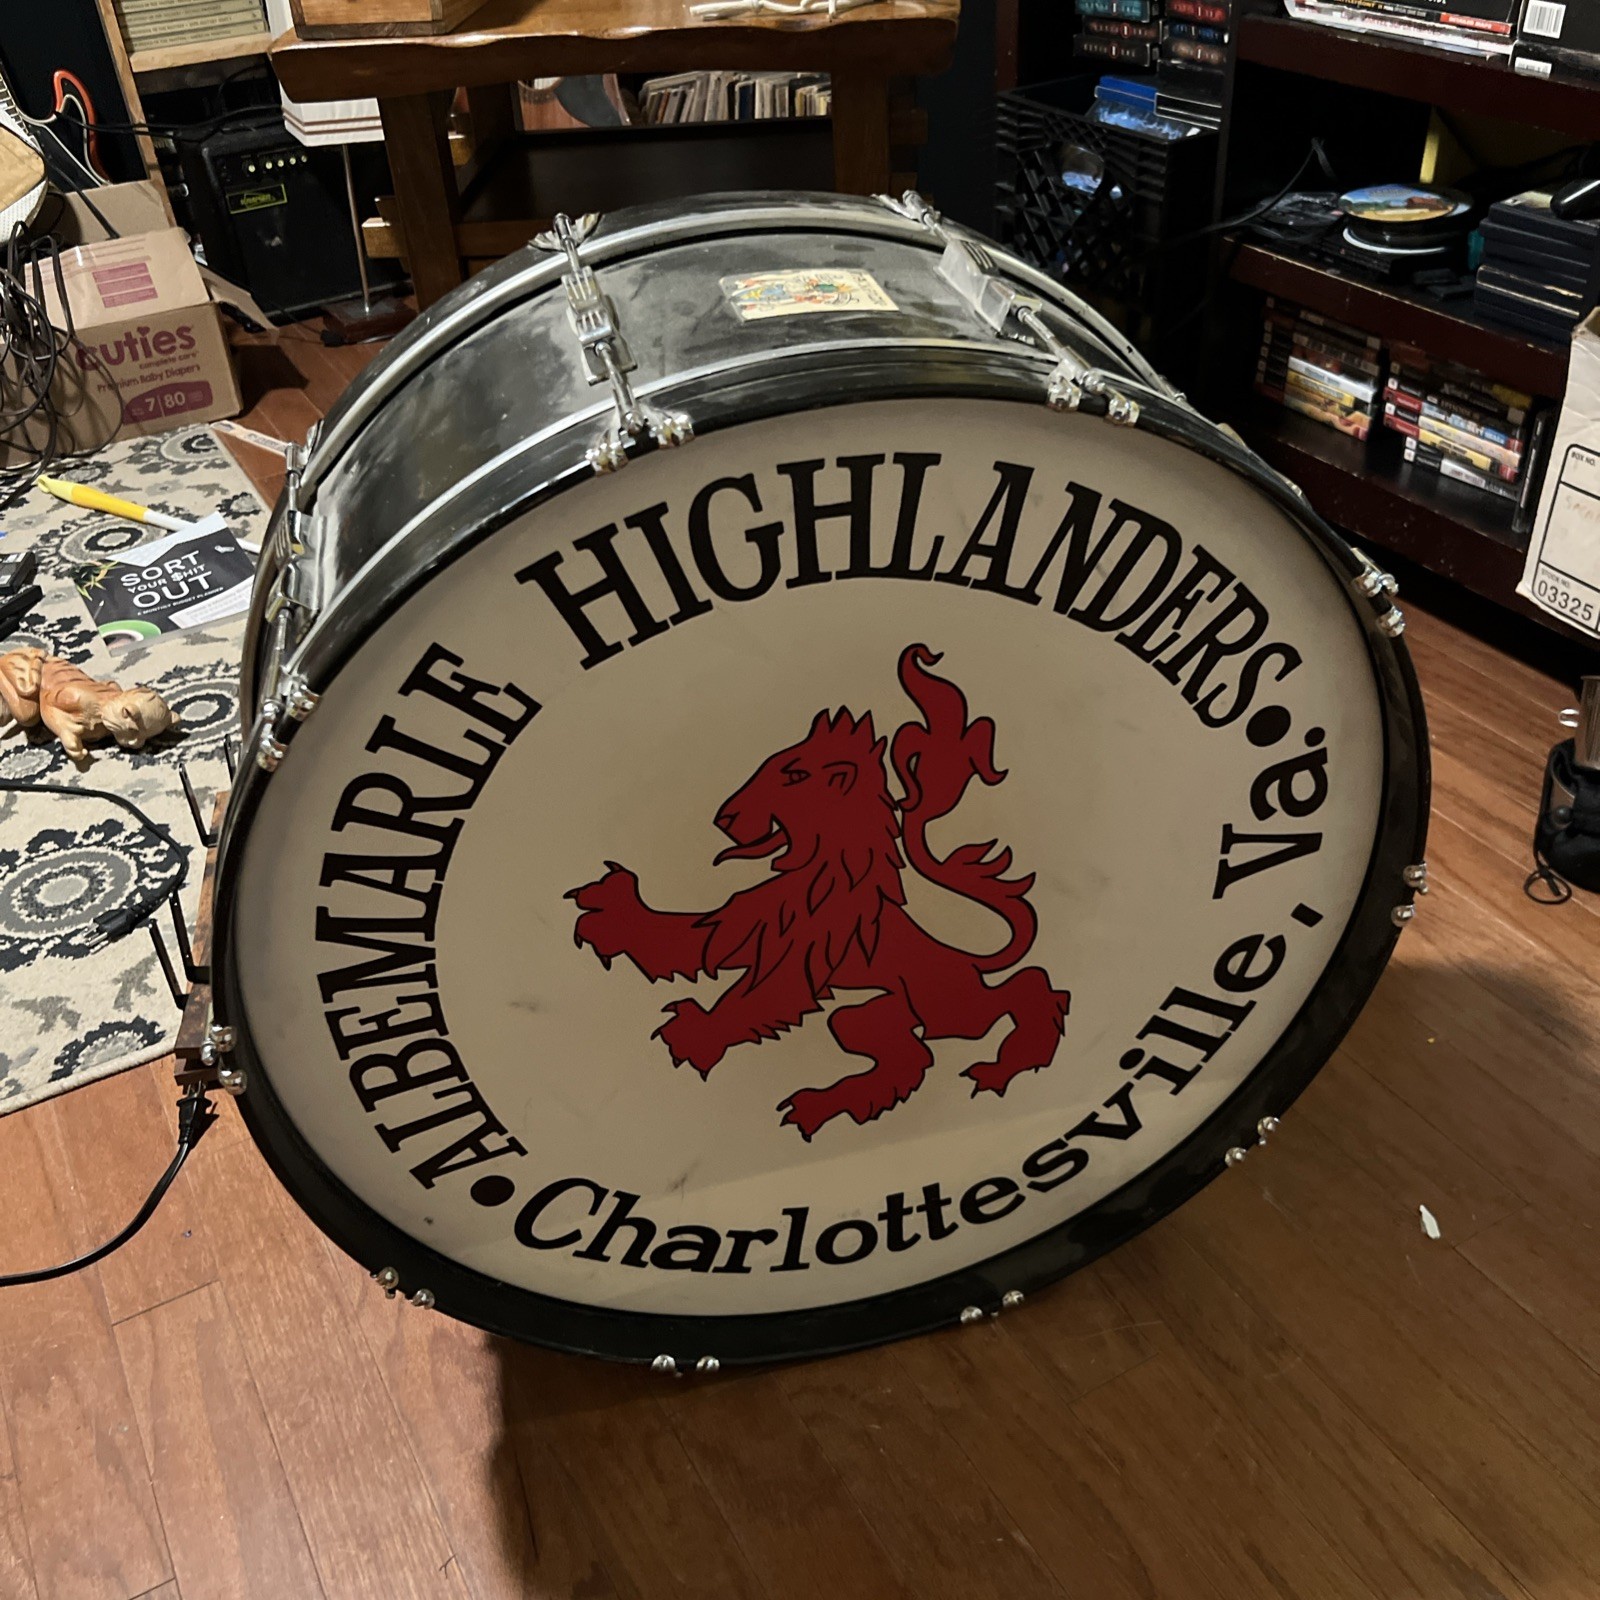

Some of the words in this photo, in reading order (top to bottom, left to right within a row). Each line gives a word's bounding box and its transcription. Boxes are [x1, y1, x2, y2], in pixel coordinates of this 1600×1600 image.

[75, 325, 197, 371] cuties
[140, 370, 164, 383] Baby
[165, 364, 201, 378] Diapers
[145, 397, 156, 412] 7
[164, 391, 186, 408] 80
[120, 550, 199, 587] SORT
[127, 578, 167, 593] YOUR
[132, 570, 212, 608] OUT
[1537, 580, 1594, 621] 03325
[316, 643, 542, 1190] ALBEMARLE
[514, 453, 1302, 727] HIGHLANDERS
[1213, 727, 1328, 899] Va.
